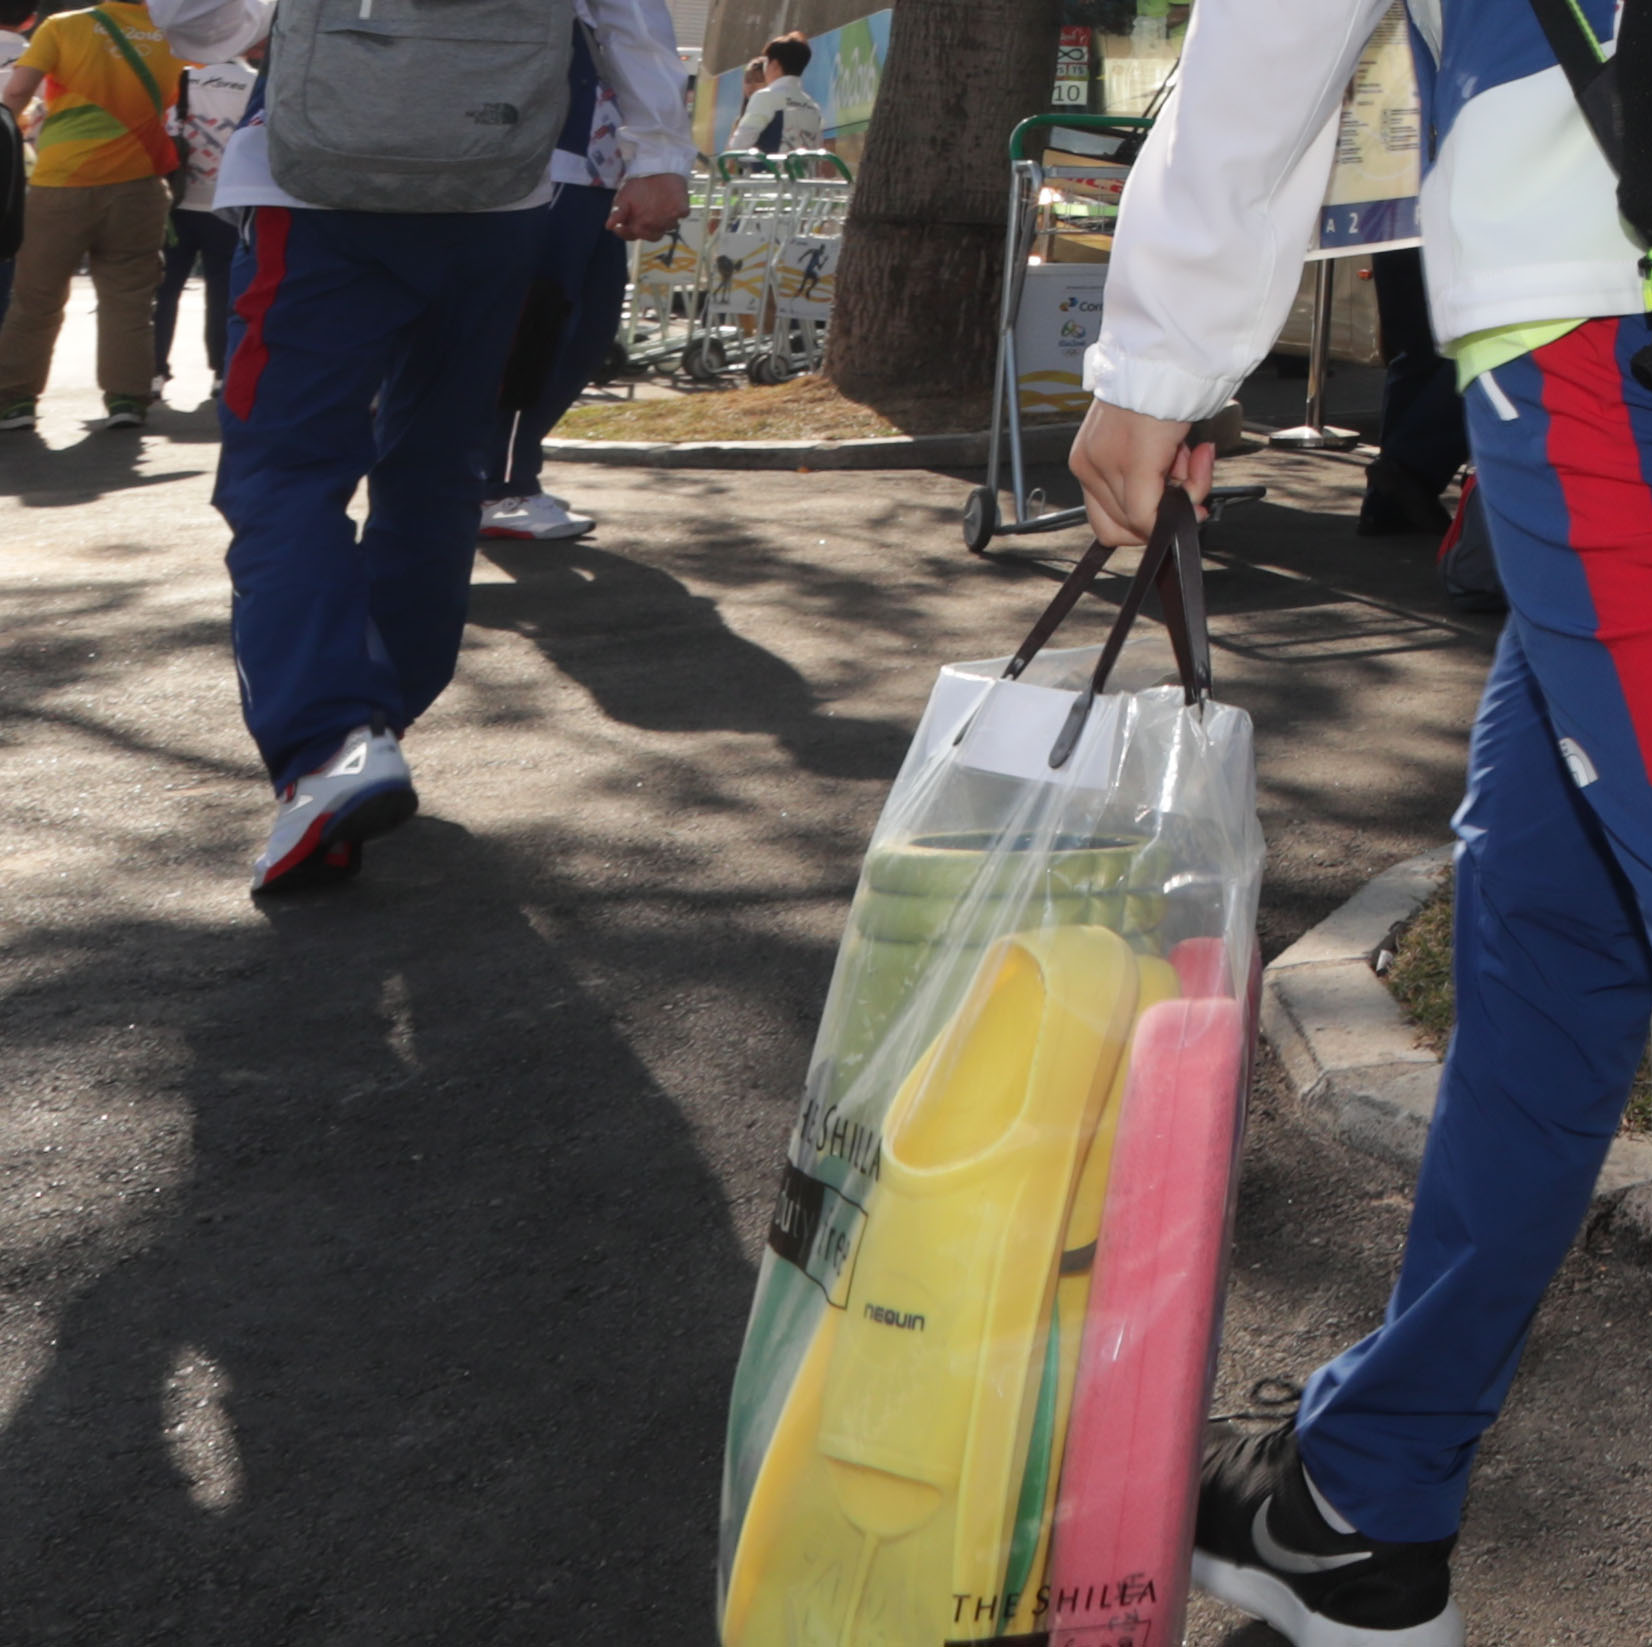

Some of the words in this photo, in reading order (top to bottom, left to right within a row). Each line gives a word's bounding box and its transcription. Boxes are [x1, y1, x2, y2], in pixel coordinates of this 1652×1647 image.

[1348, 212, 1359, 234] 2
[815, 1104, 883, 1182] SHILLA
[952, 1593, 1020, 1623] THE
[1032, 1578, 1157, 1617] SHILLA
